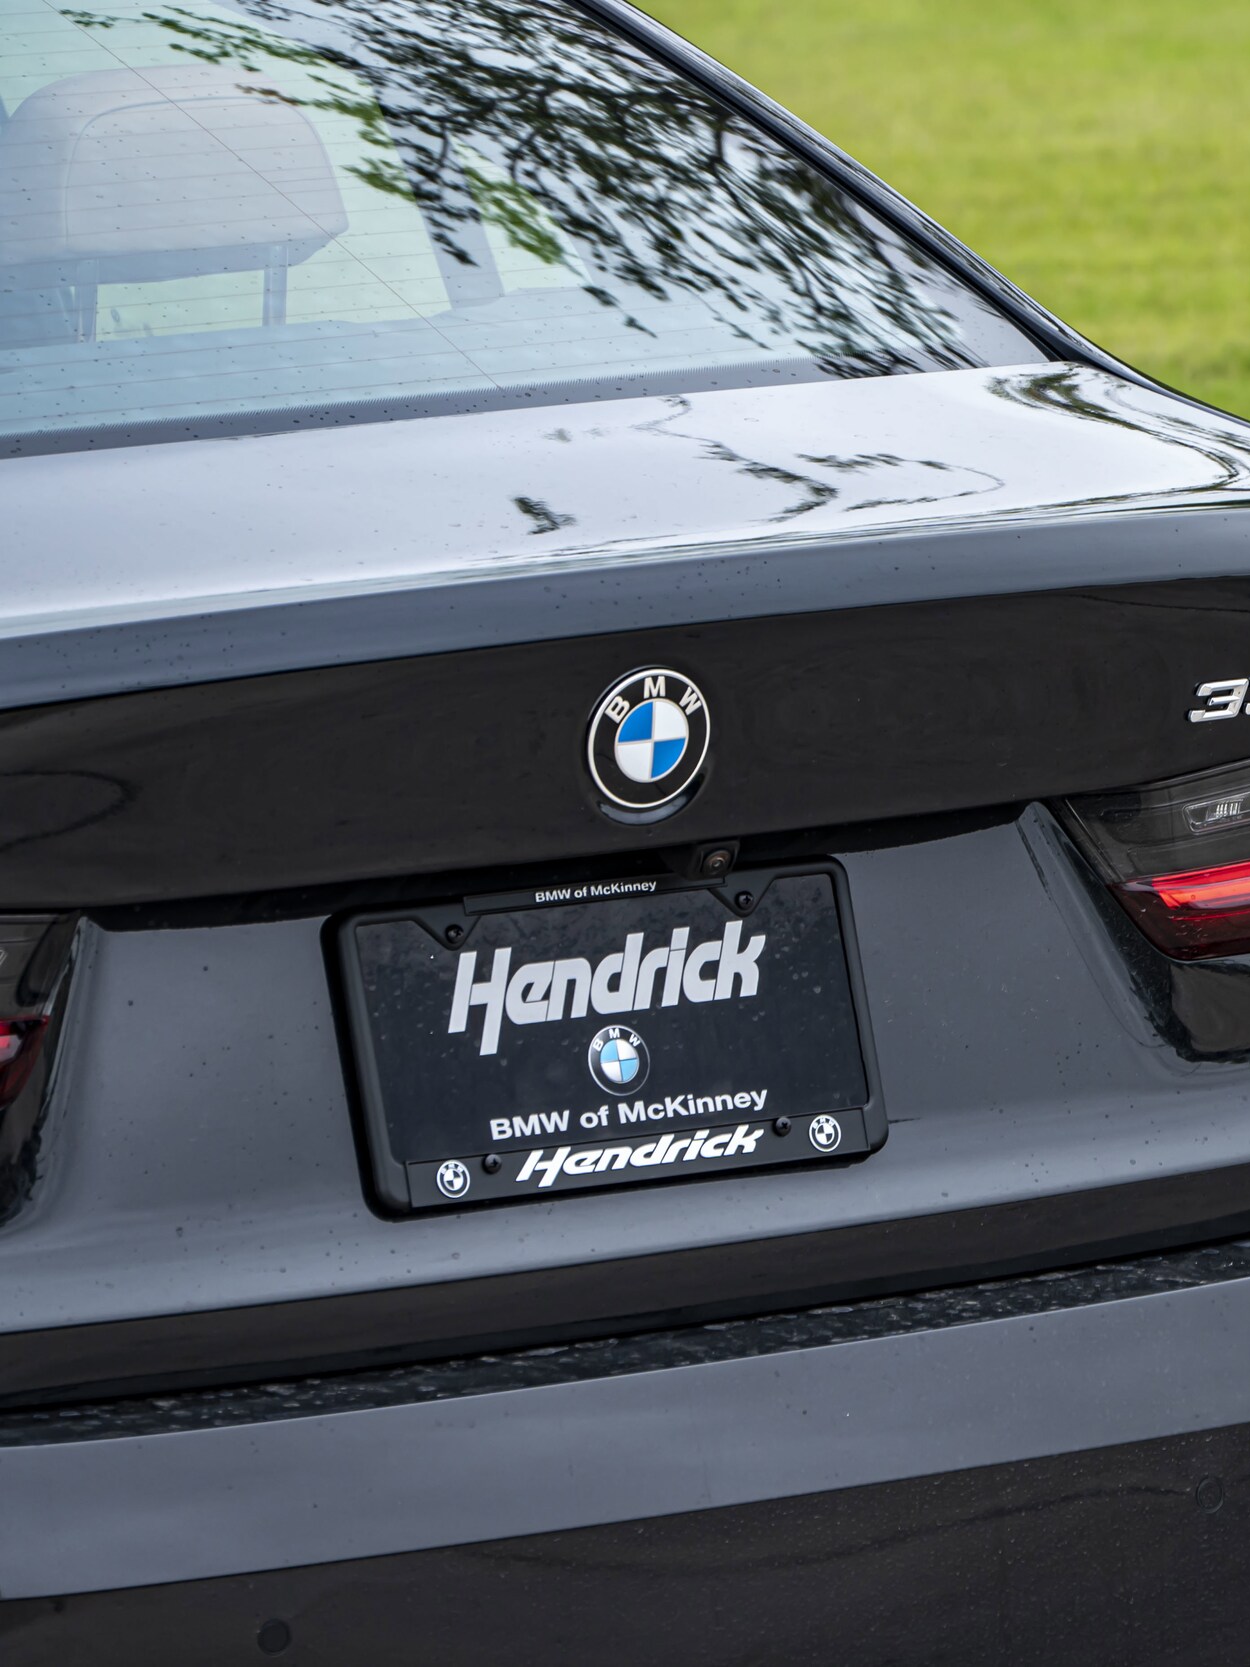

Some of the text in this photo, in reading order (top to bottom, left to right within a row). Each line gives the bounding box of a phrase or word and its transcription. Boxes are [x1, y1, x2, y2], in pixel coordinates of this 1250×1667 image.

[604, 675, 702, 724] BMW
[535, 881, 657, 903] BMW of McKinney
[448, 920, 766, 1056] Hendrick
[592, 1027, 641, 1052] BMW
[489, 1089, 768, 1141] BMW of McKinney
[515, 1124, 765, 1188] Hendrick
